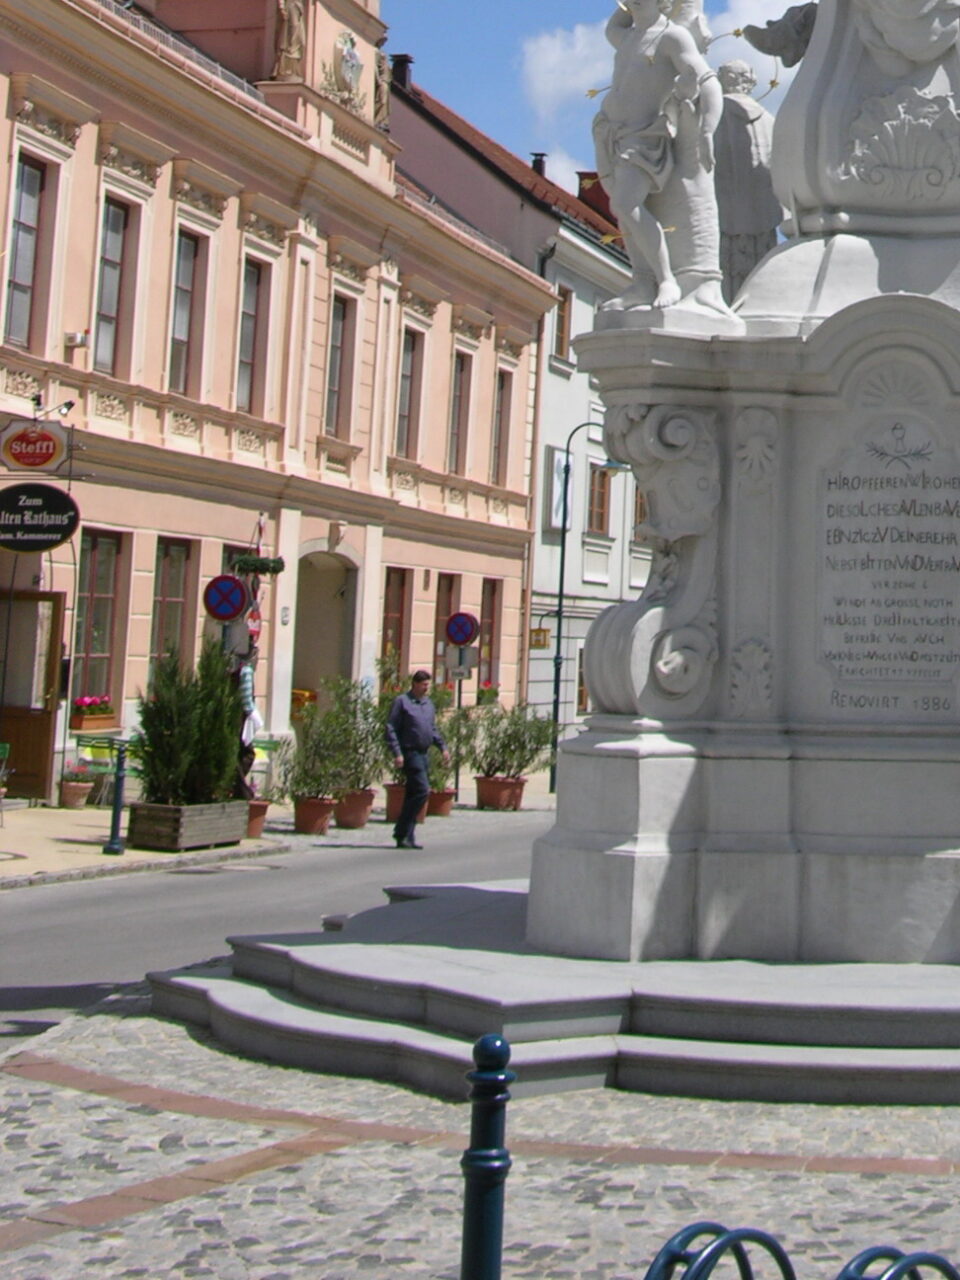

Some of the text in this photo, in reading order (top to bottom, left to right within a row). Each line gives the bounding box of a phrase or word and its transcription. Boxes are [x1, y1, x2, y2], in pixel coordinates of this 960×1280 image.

[11, 441, 54, 454] Steffl
[18, 495, 43, 506] Zum
[0, 510, 22, 525] lten
[831, 689, 951, 711] RENOVIRT 1886
